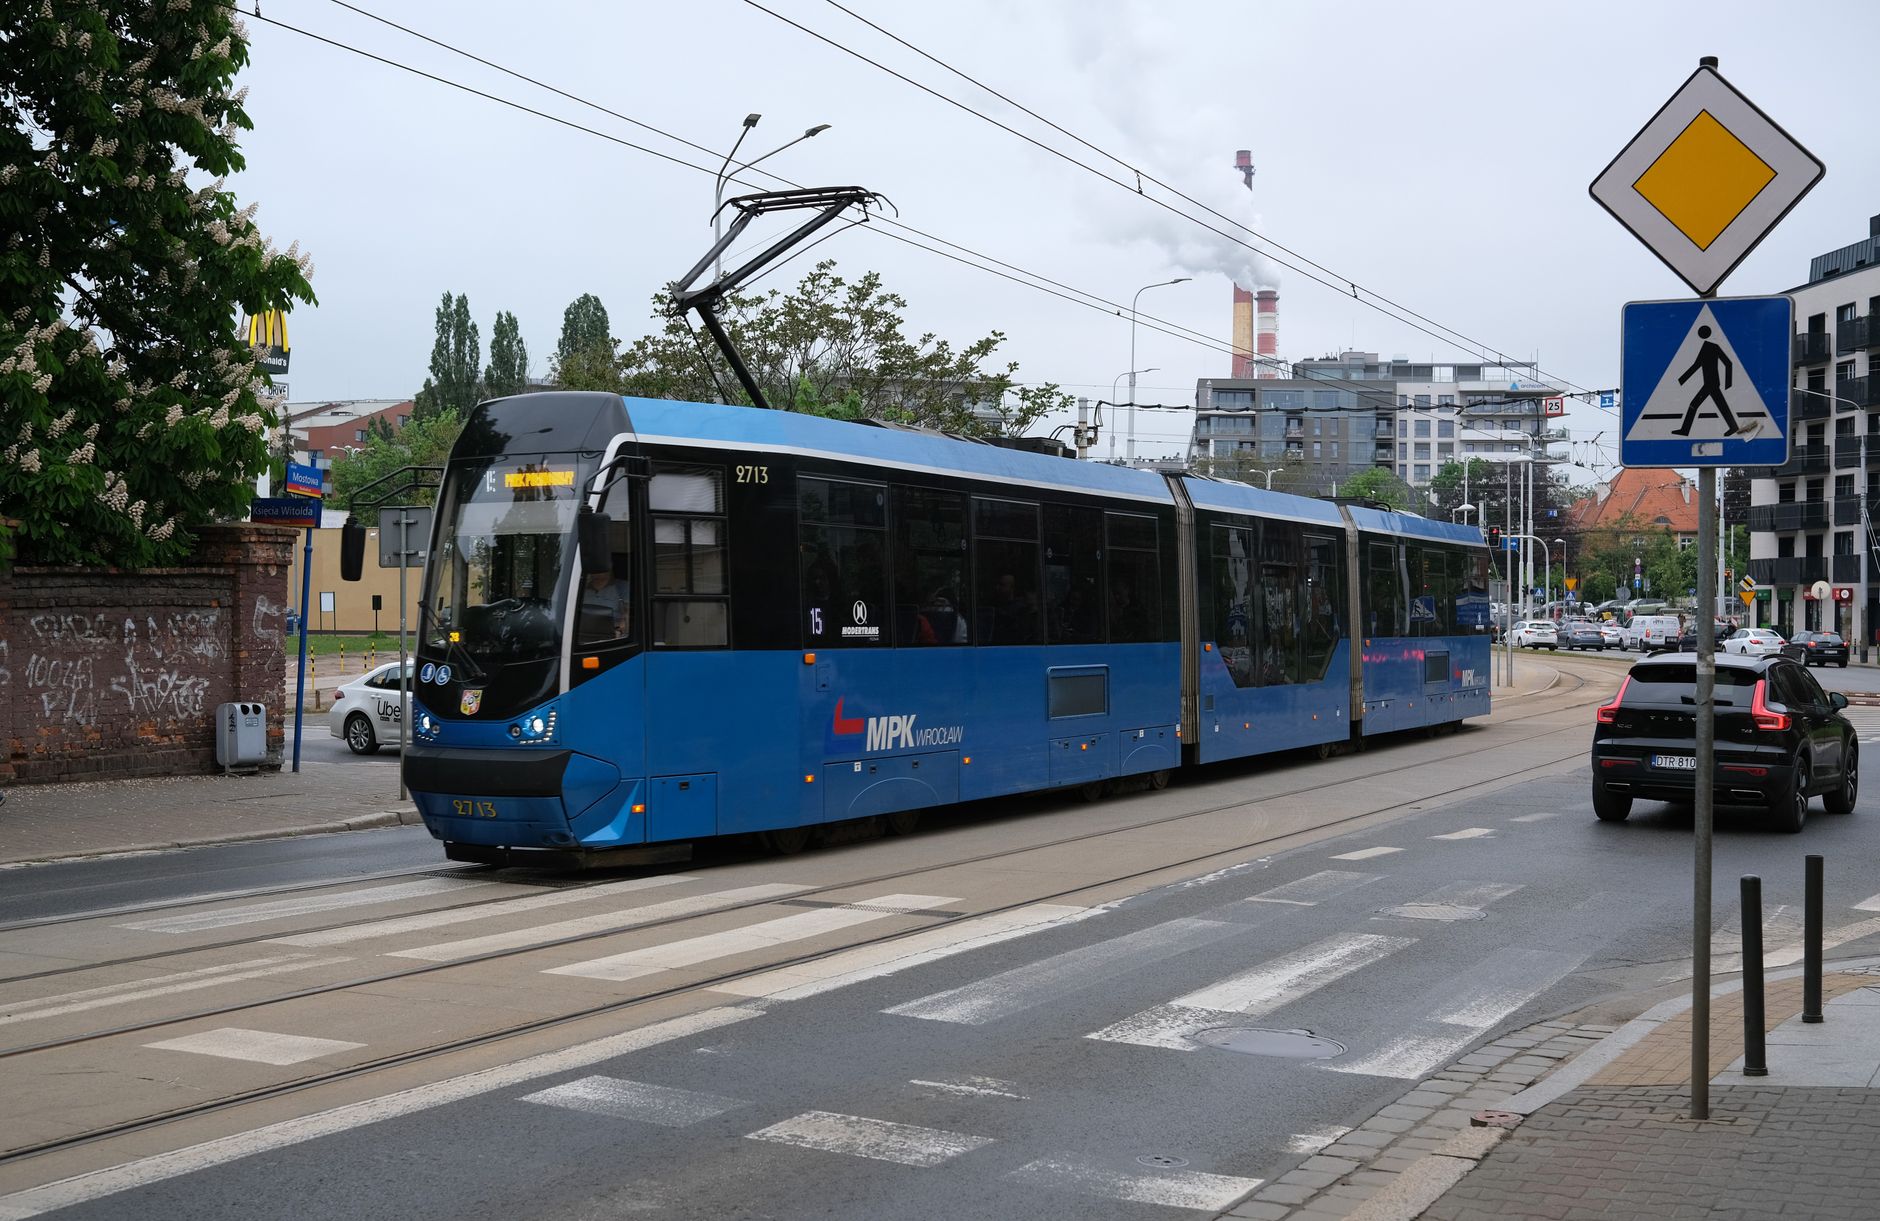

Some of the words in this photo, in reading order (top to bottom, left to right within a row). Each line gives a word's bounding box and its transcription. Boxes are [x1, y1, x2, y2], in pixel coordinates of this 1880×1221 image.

[1548, 402, 1560, 411] 25
[292, 472, 319, 486] Mostowa
[736, 465, 769, 484] 2713
[252, 506, 279, 517] Księcia
[281, 506, 313, 516] Witolda
[810, 607, 823, 635] 15
[841, 626, 880, 635] MODERTRANS
[1461, 669, 1475, 687] MPK
[377, 700, 401, 717] Ube
[866, 714, 917, 752] MPK
[916, 726, 964, 747] WROCŁAW
[1656, 756, 1676, 767] DTR
[1678, 757, 1696, 768] 810
[453, 799, 497, 818] 2713
